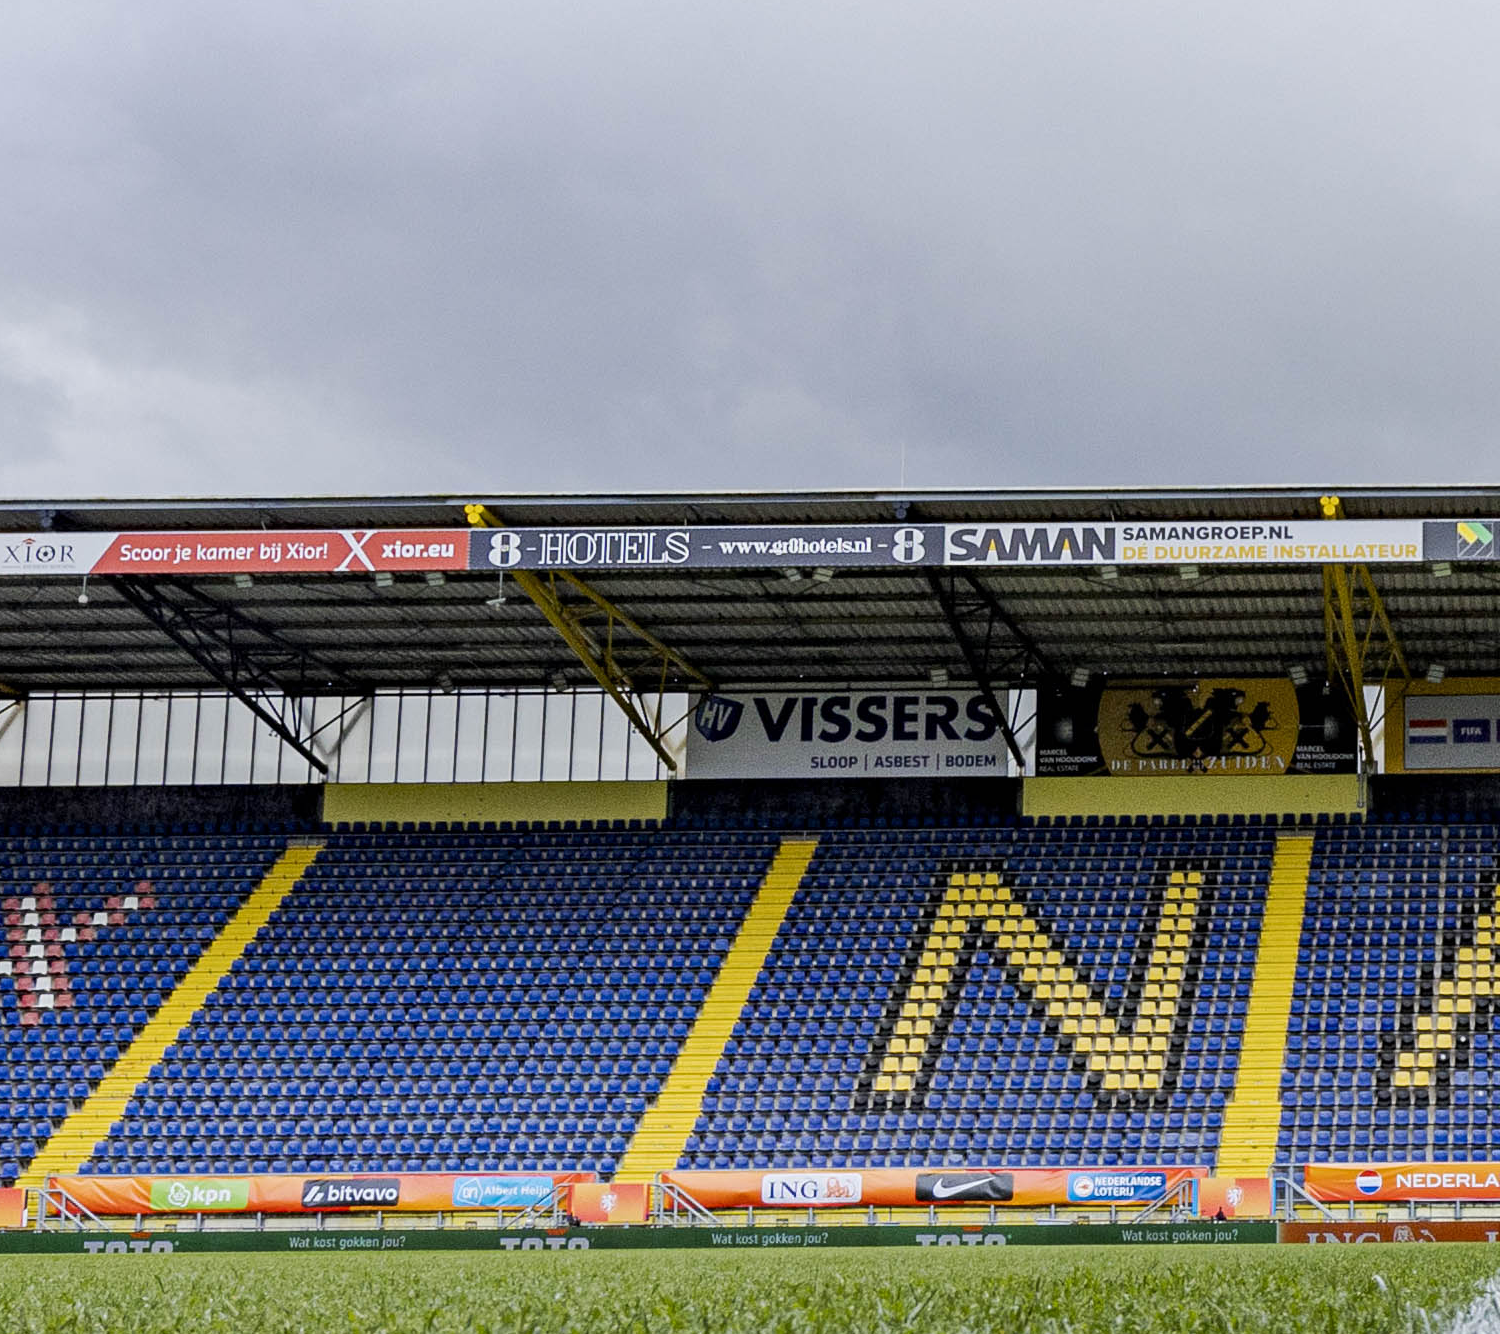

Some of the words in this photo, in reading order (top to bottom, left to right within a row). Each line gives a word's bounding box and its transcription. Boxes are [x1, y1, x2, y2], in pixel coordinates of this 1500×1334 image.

[1122, 525, 1294, 542] SAMANGROEP.NL
[4, 543, 76, 564] XIOR
[120, 543, 170, 562] Scoor
[174, 544, 191, 563] je
[196, 542, 254, 561] kamer
[259, 541, 282, 563] bij
[286, 541, 329, 560] Xior!
[381, 540, 455, 559] xior.eu
[538, 531, 690, 564] HOTELS
[718, 536, 873, 556] www.gr8hotels.nl
[949, 526, 1116, 562] SAMAN
[1122, 542, 1149, 561] DÉ
[1154, 544, 1268, 560] DUURZAME
[1273, 543, 1418, 559] INSTALLATEUR
[753, 695, 999, 744] VISSERS
[1460, 726, 1482, 736] FIFA
[810, 756, 858, 771] SLOOP
[874, 755, 930, 770] ASBEST
[945, 754, 997, 770] BODEM
[767, 1180, 819, 1200] ING
[1094, 1175, 1163, 1187] NEDERLANDSE
[191, 1186, 232, 1205] kpn
[327, 1183, 399, 1203] bitvavo
[484, 1186, 519, 1196] Albert
[1093, 1186, 1135, 1198] LOTERIJ
[289, 1237, 310, 1248] Wat
[314, 1237, 336, 1248] kost
[340, 1237, 379, 1251] gokken
[382, 1236, 406, 1250] jou?
